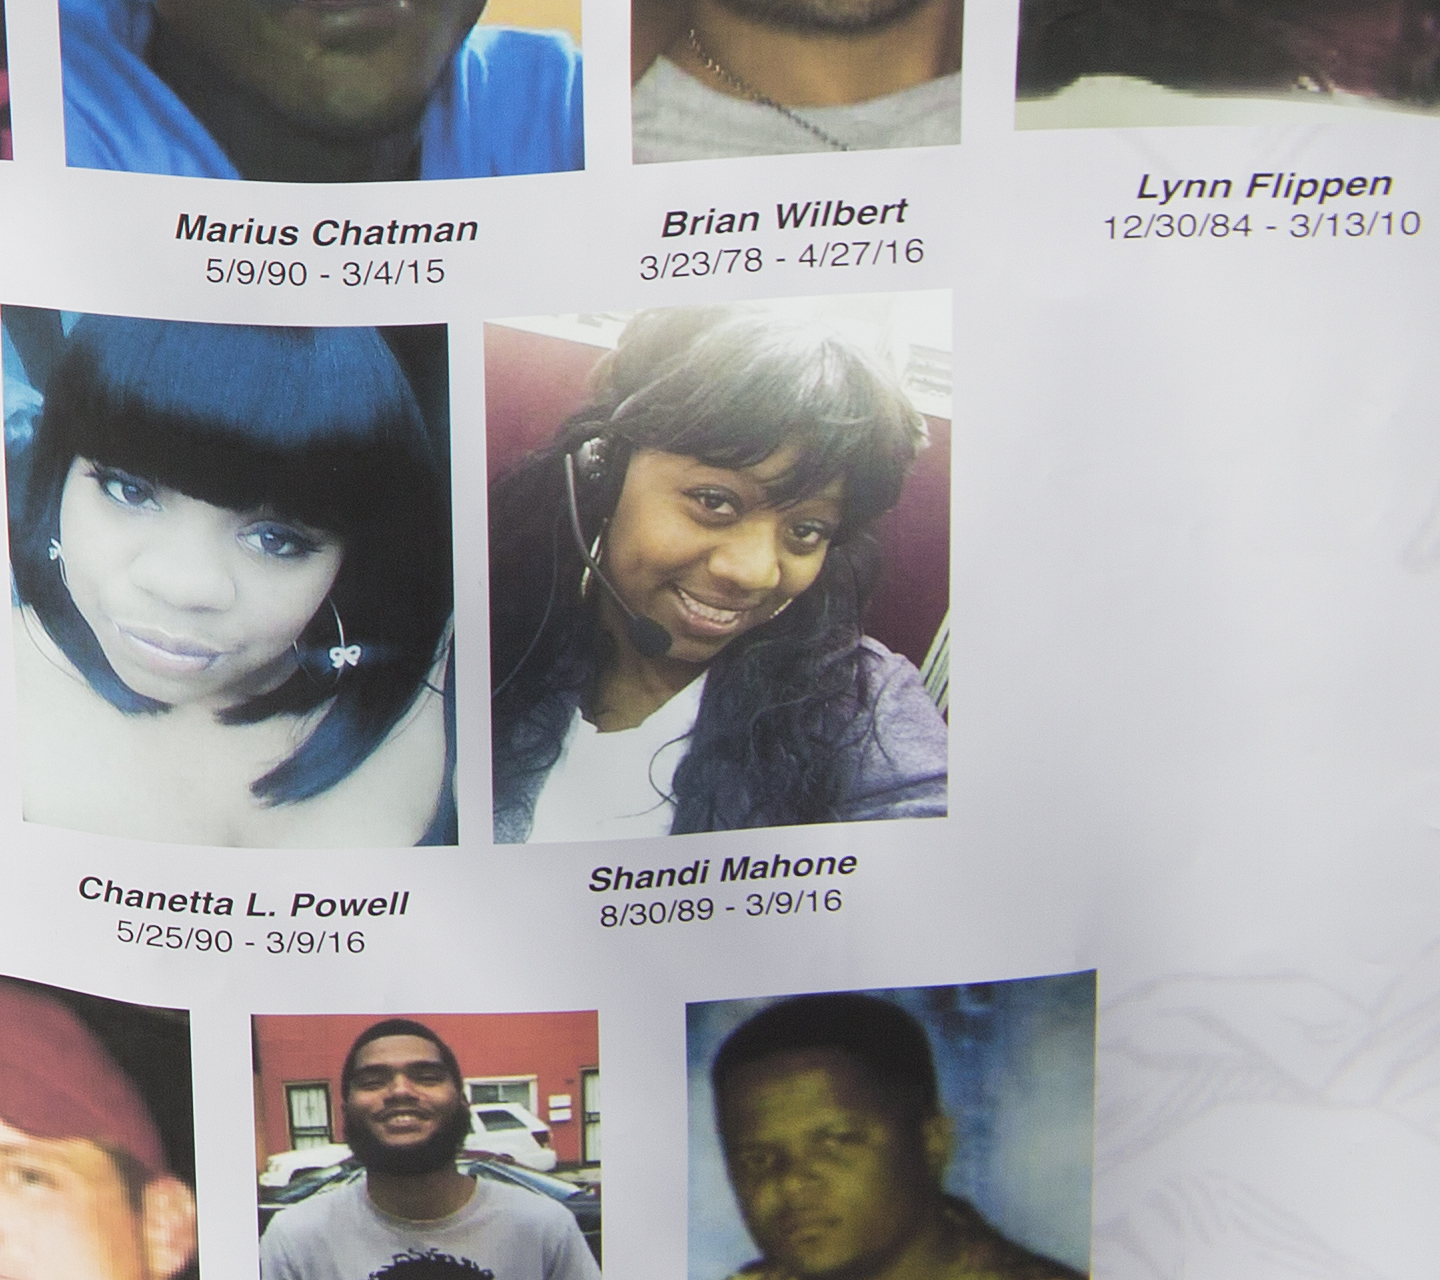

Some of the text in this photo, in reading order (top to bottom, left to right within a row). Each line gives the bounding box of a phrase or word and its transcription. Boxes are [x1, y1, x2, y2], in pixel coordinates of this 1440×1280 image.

[1137, 172, 1393, 206] Lynn Flippen
[175, 213, 478, 247] Marius Chatman
[661, 198, 909, 238] Brian Wilbert
[1105, 213, 1251, 239] 12/30/84
[1290, 211, 1420, 238] 3/13/10
[206, 258, 308, 287] 5/9/90
[342, 258, 445, 287] 3/4/15
[640, 247, 763, 281] 3/23/78
[798, 238, 924, 268] 4/27/16
[588, 853, 858, 893] Shandi Mahone
[78, 876, 410, 918] Chanetta L. Powell
[600, 897, 714, 928] 8/30/89
[746, 889, 842, 917] 3/9/16
[117, 919, 233, 953] 5/25/90
[266, 930, 365, 954] 3/9/16
